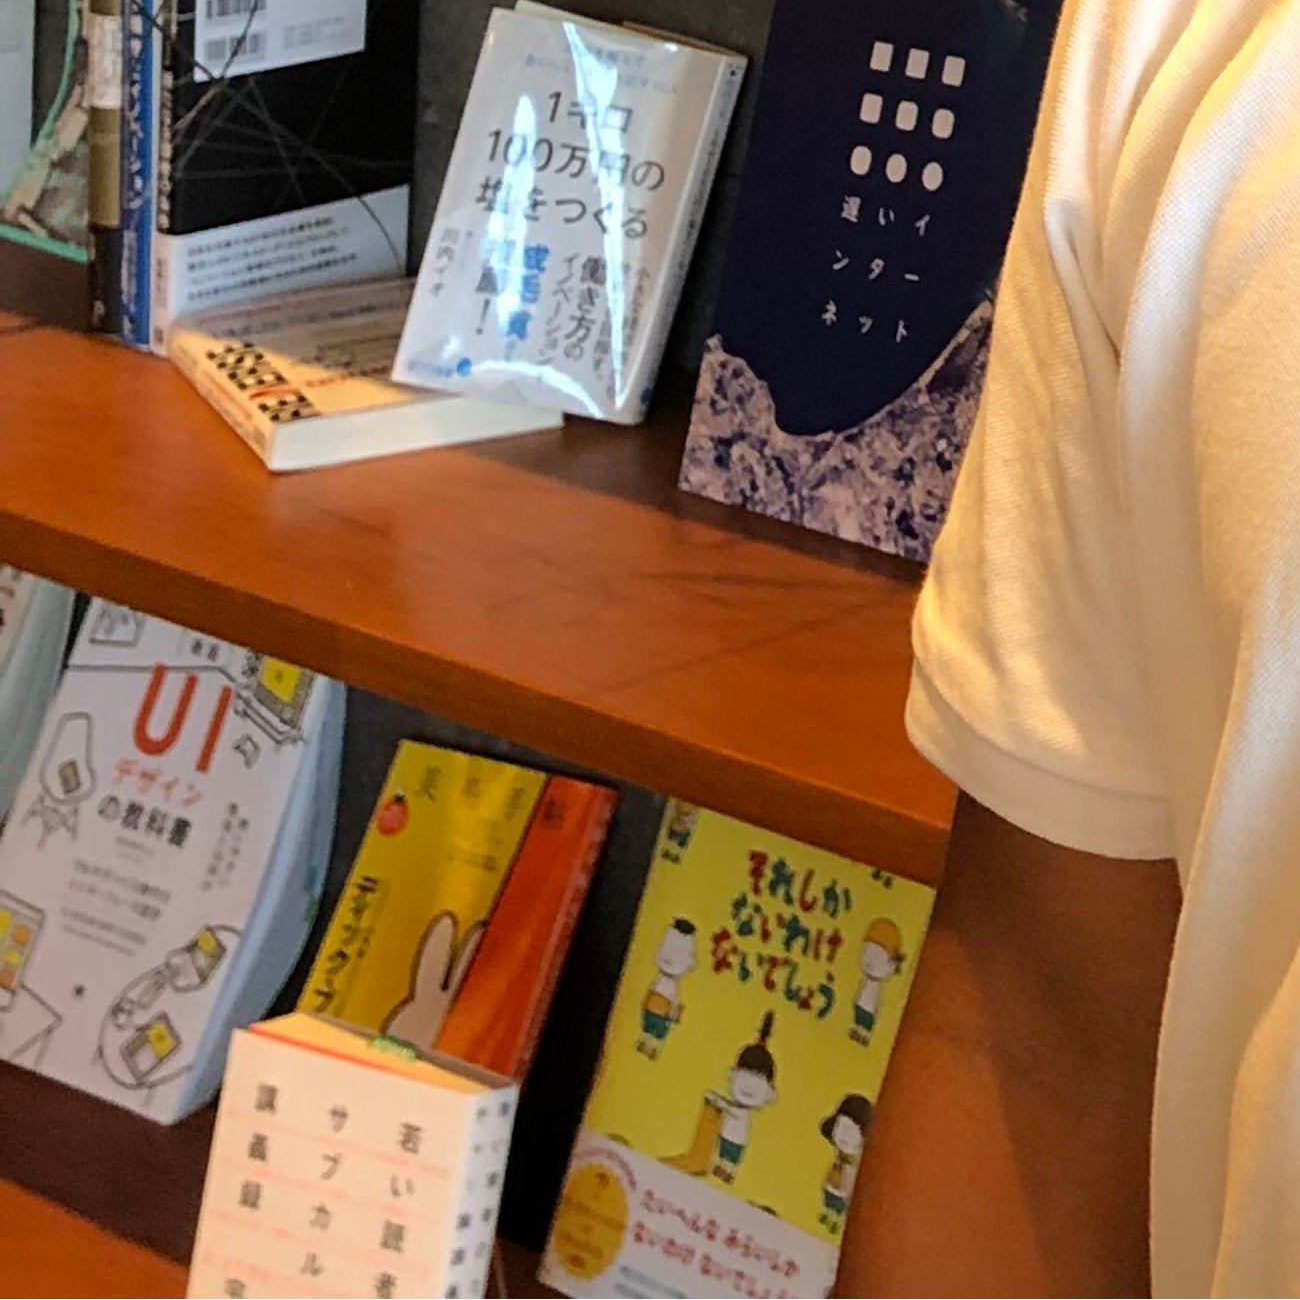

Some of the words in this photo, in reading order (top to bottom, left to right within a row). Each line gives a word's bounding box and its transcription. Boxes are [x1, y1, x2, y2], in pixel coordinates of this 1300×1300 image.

[133, 661, 234, 774] UI
[730, 892, 844, 964] ないわけ
[747, 848, 853, 919] それしか
[710, 927, 837, 1020] ないでしょう
[298, 1103, 351, 1281] サブカル
